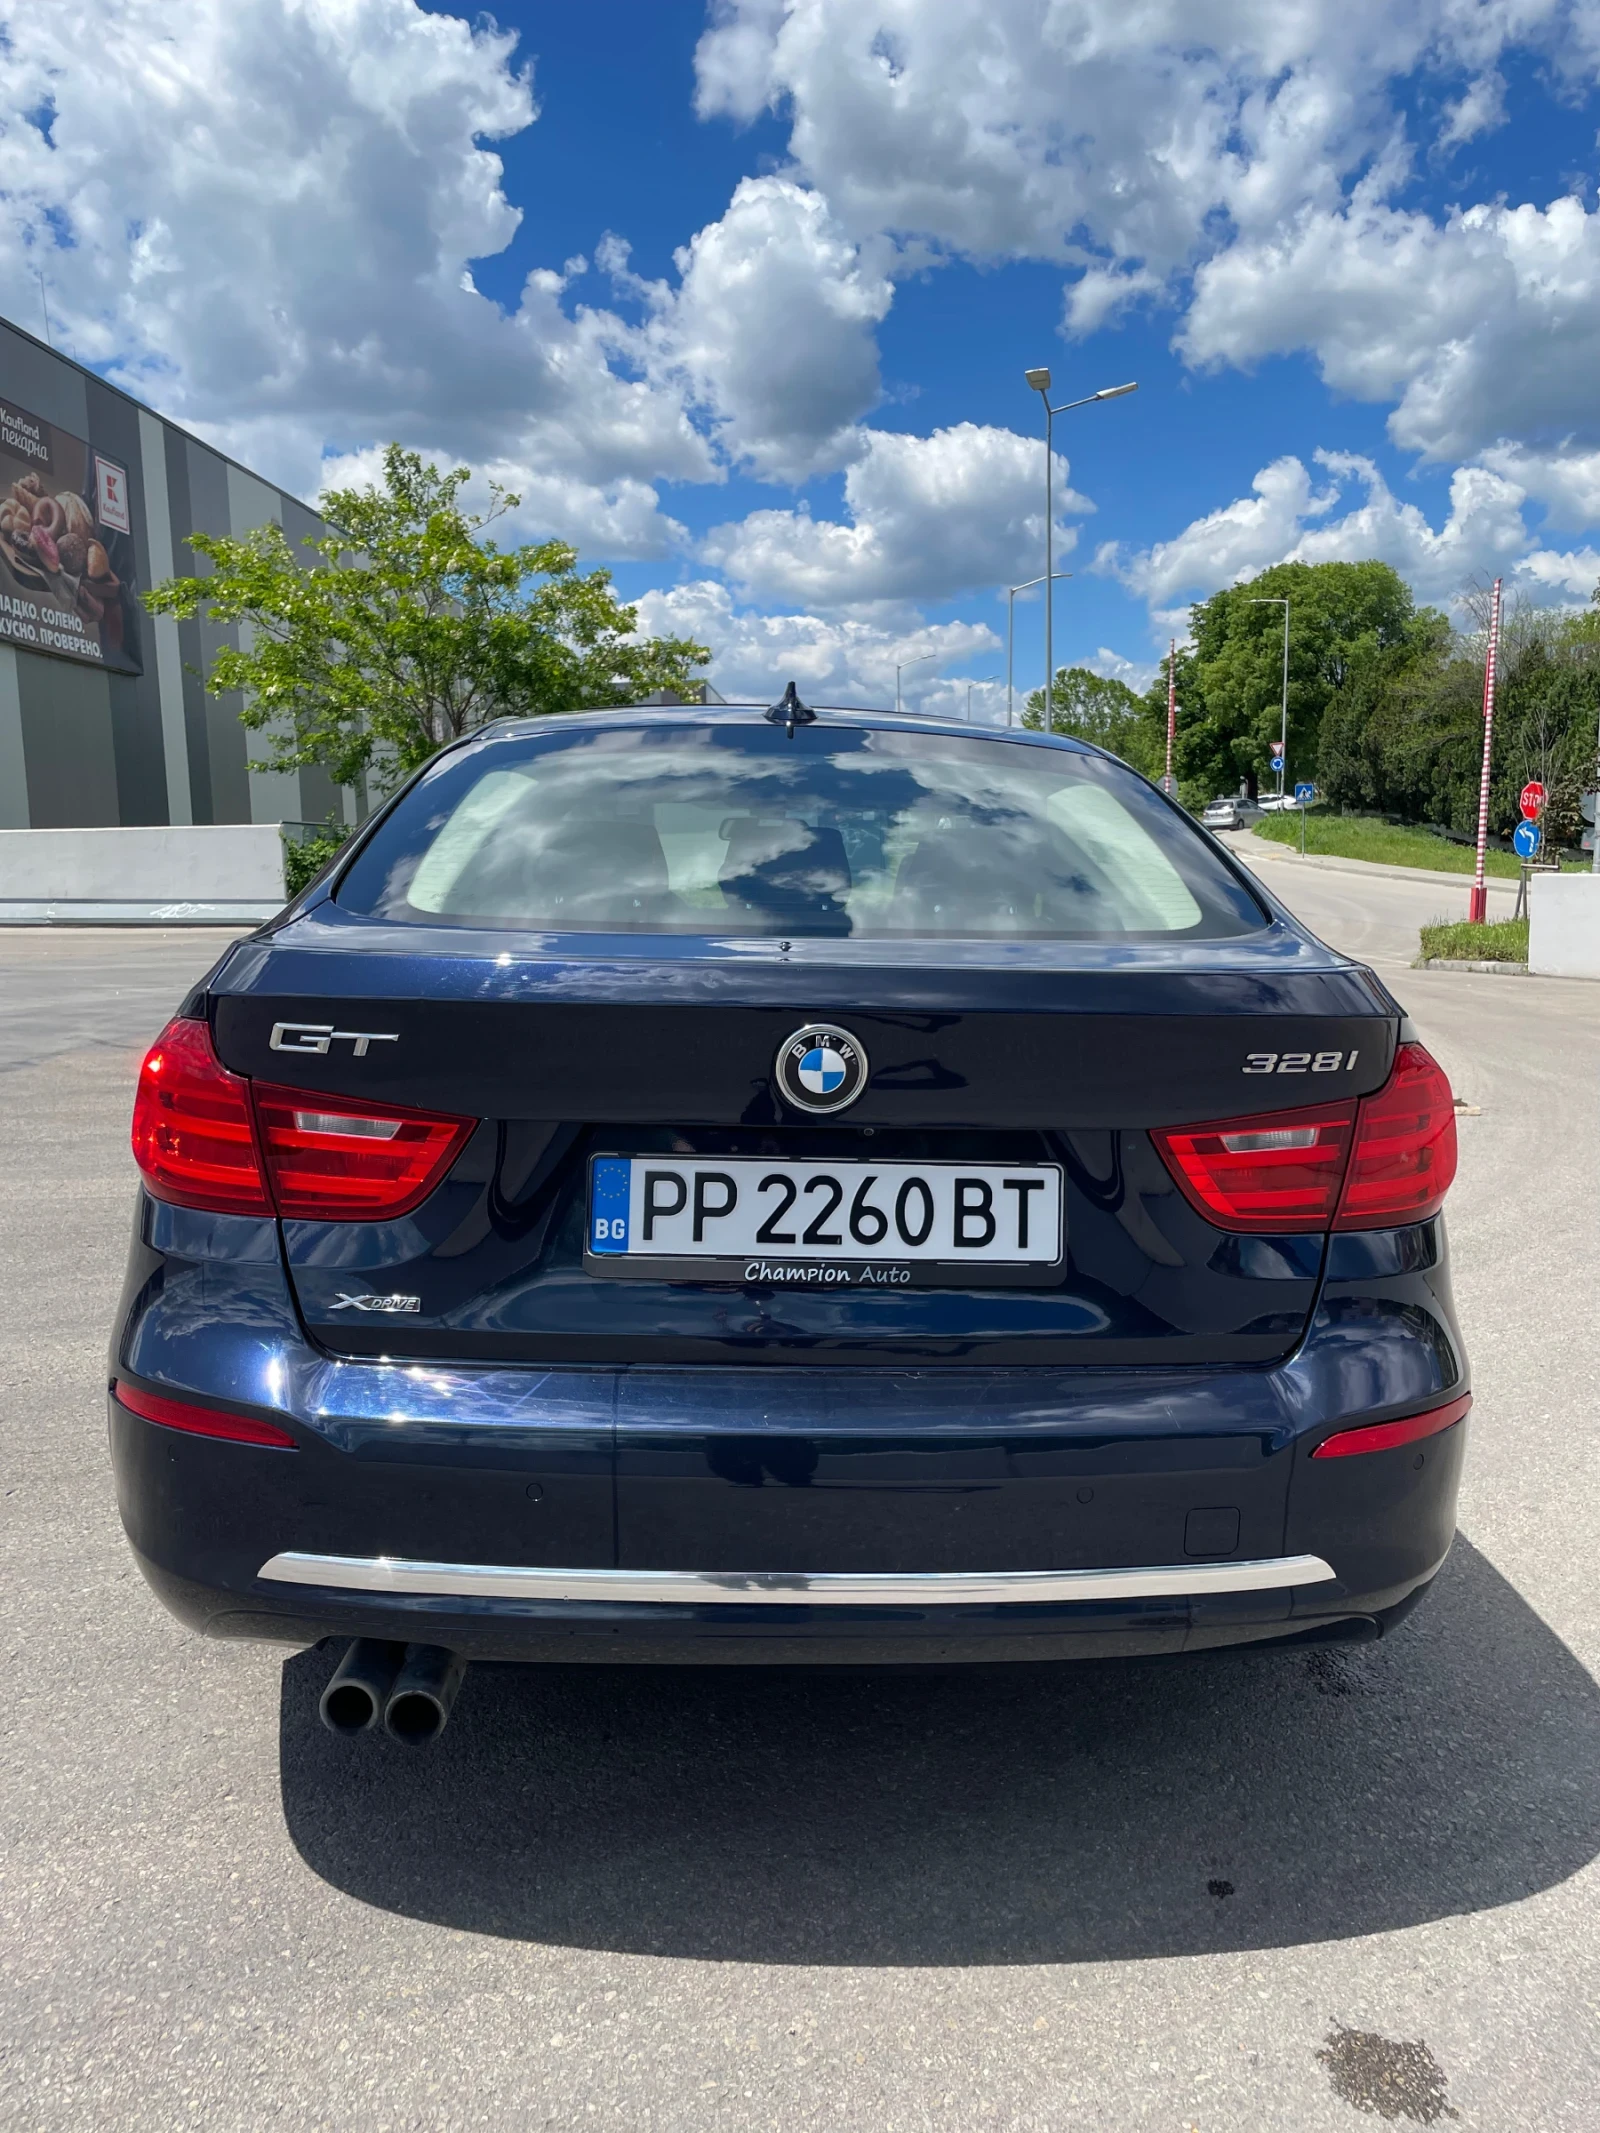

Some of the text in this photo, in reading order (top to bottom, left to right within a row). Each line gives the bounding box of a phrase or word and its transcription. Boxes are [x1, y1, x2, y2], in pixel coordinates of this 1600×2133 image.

[0, 407, 40, 440] Kaufland
[103, 502, 125, 520] Kaufland
[41, 606, 86, 634] СОЛЕНО.
[40, 627, 104, 659] ПРОВЕРЕНО.
[269, 1022, 401, 1057] GT
[791, 1034, 855, 1061] BMW
[641, 1170, 1046, 1249] PP 2260 BT
[595, 1217, 626, 1241] BG
[744, 1260, 912, 1284] Champion Auto
